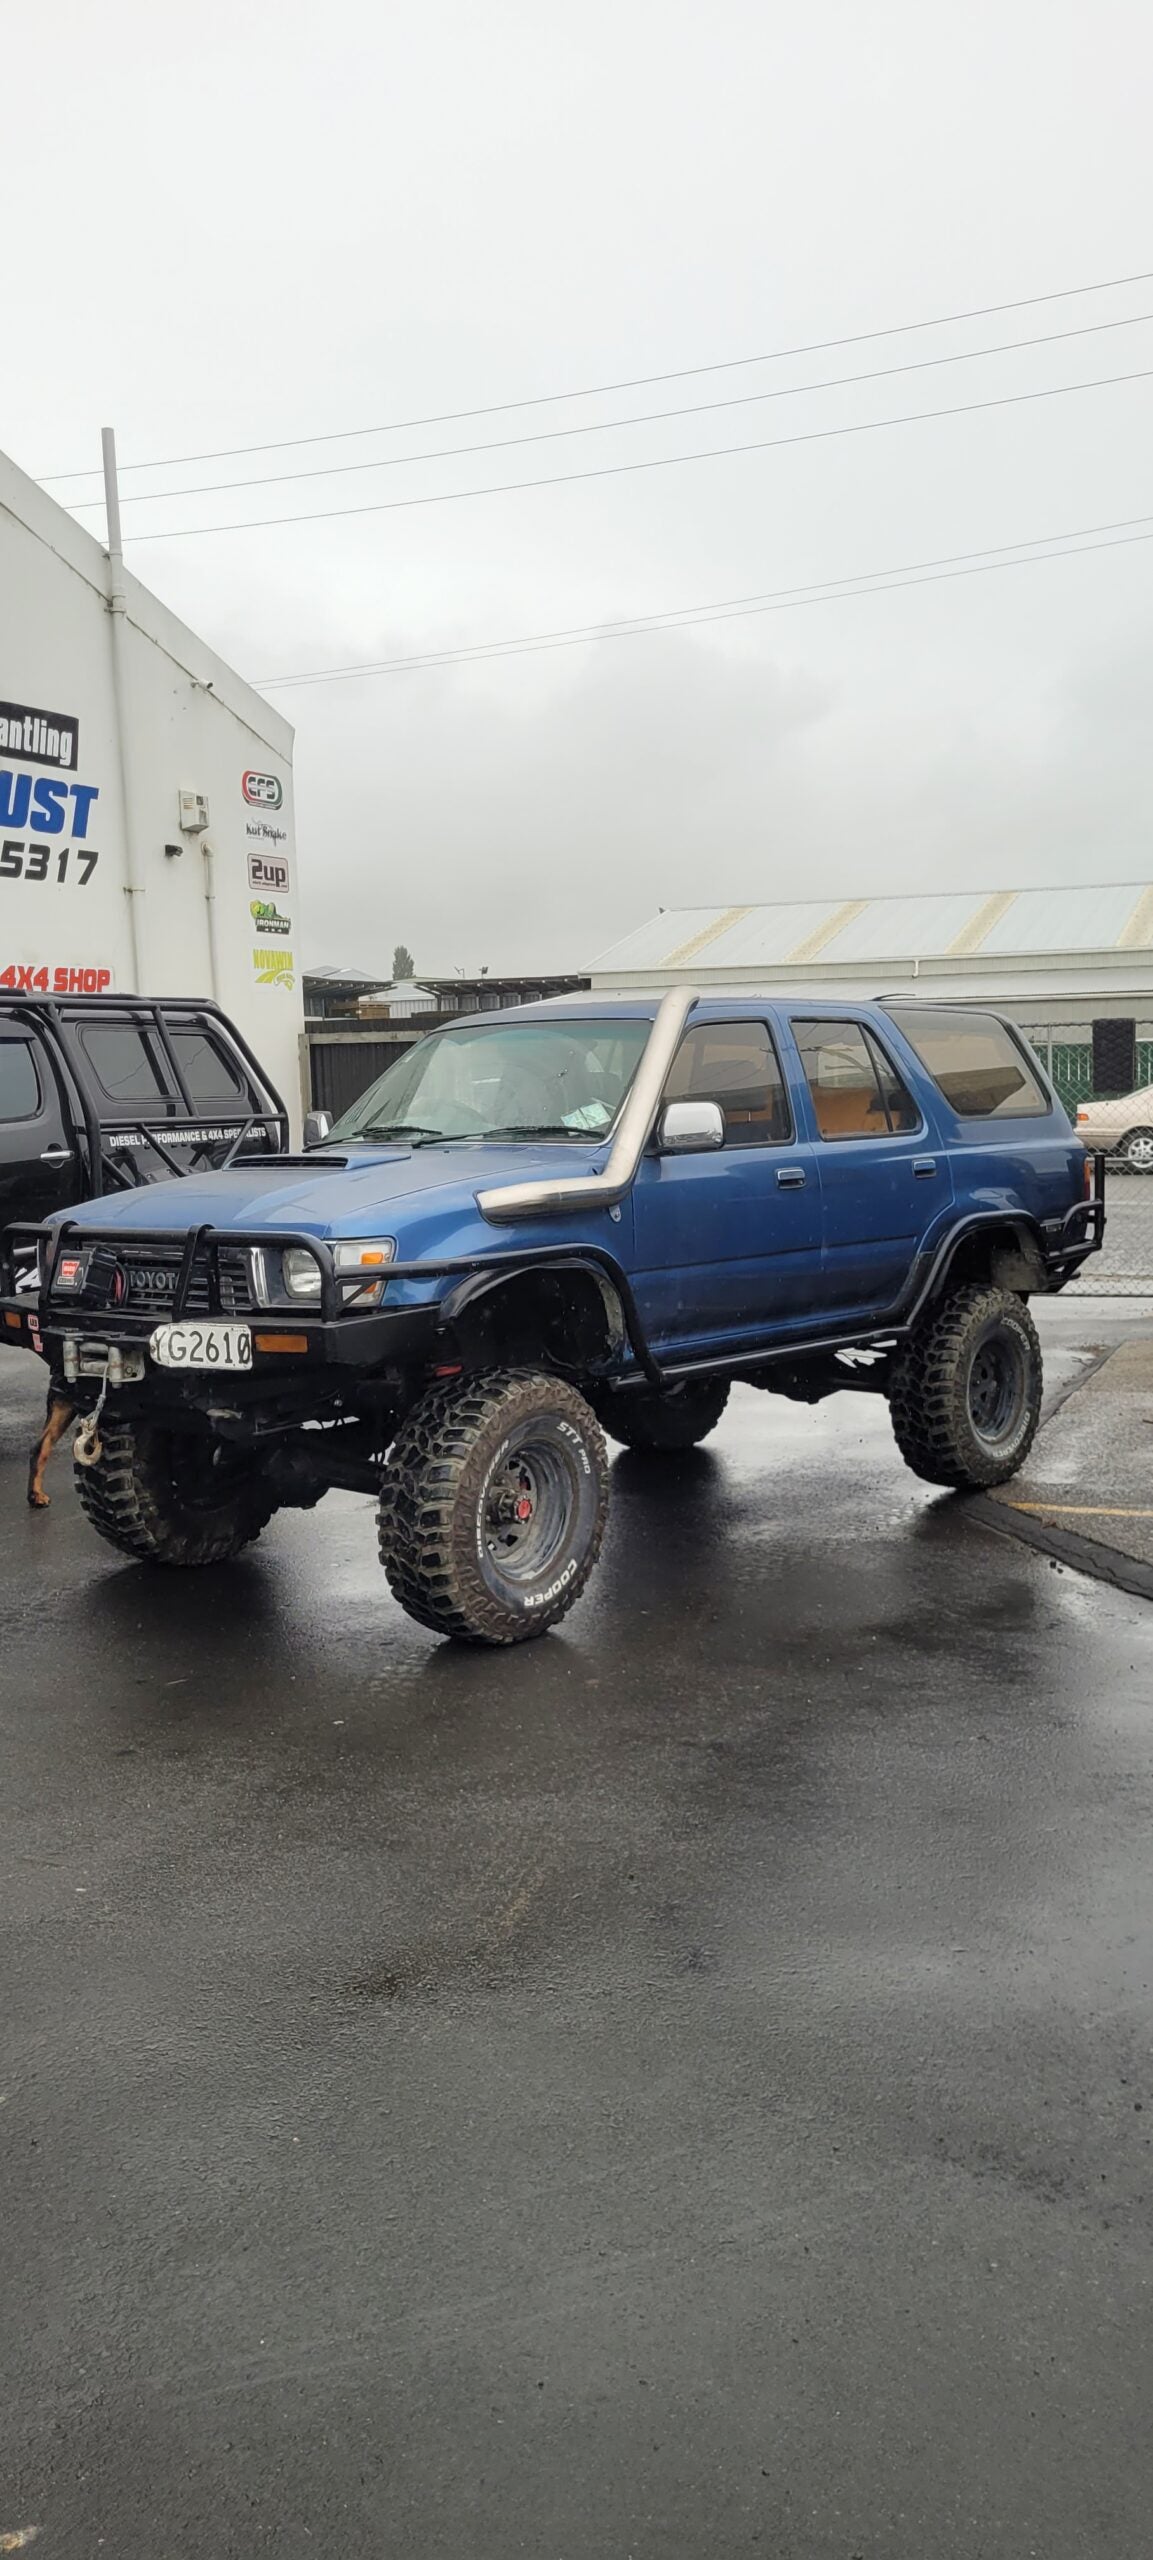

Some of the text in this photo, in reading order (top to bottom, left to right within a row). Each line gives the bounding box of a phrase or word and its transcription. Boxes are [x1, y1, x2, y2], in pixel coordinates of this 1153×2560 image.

[0, 715, 73, 766] antling
[0, 769, 99, 839] UST
[0, 840, 99, 886] 5317
[251, 858, 286, 888] 2up
[257, 918, 290, 929] IRONMAN
[0, 965, 110, 993] 4X4 SHOP
[109, 1127, 267, 1147] DIESEL PRFORMANCE & 4X4 SPELISTS
[129, 1270, 180, 1290] TOYOT
[153, 1330, 251, 1365] YG2610
[556, 1421, 591, 1474] STT PRO
[523, 1558, 578, 1607] COOPER
